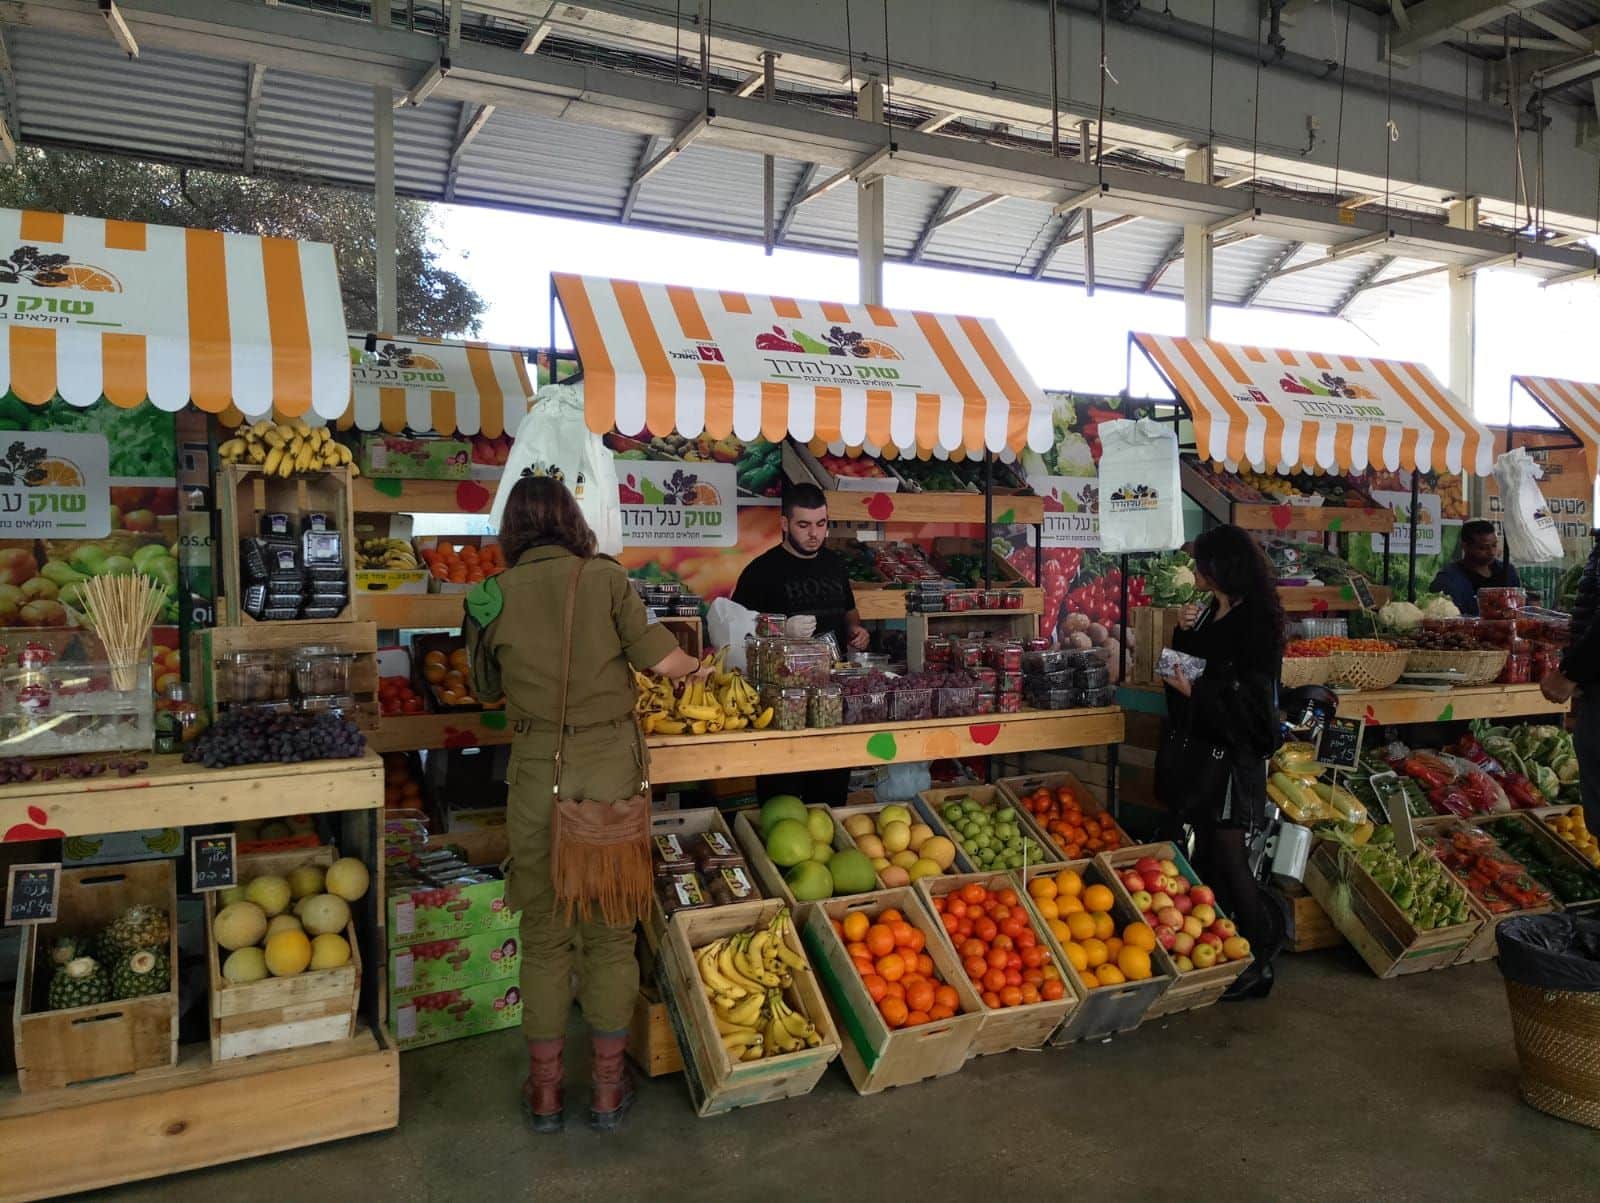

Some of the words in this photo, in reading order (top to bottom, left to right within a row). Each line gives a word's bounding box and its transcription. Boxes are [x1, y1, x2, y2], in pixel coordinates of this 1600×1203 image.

[17, 296, 94, 315] שוק
[14, 312, 70, 323] חקלאים
[763, 358, 821, 374] הדרך
[820, 360, 853, 376] על
[854, 365, 900, 379] שוק
[402, 371, 445, 382] שוק
[28, 493, 86, 515] שוק
[16, 520, 52, 528] חקלאים
[620, 509, 653, 526] הדר
[656, 506, 681, 526] על
[684, 510, 722, 528] שוק
[1072, 514, 1090, 530] על
